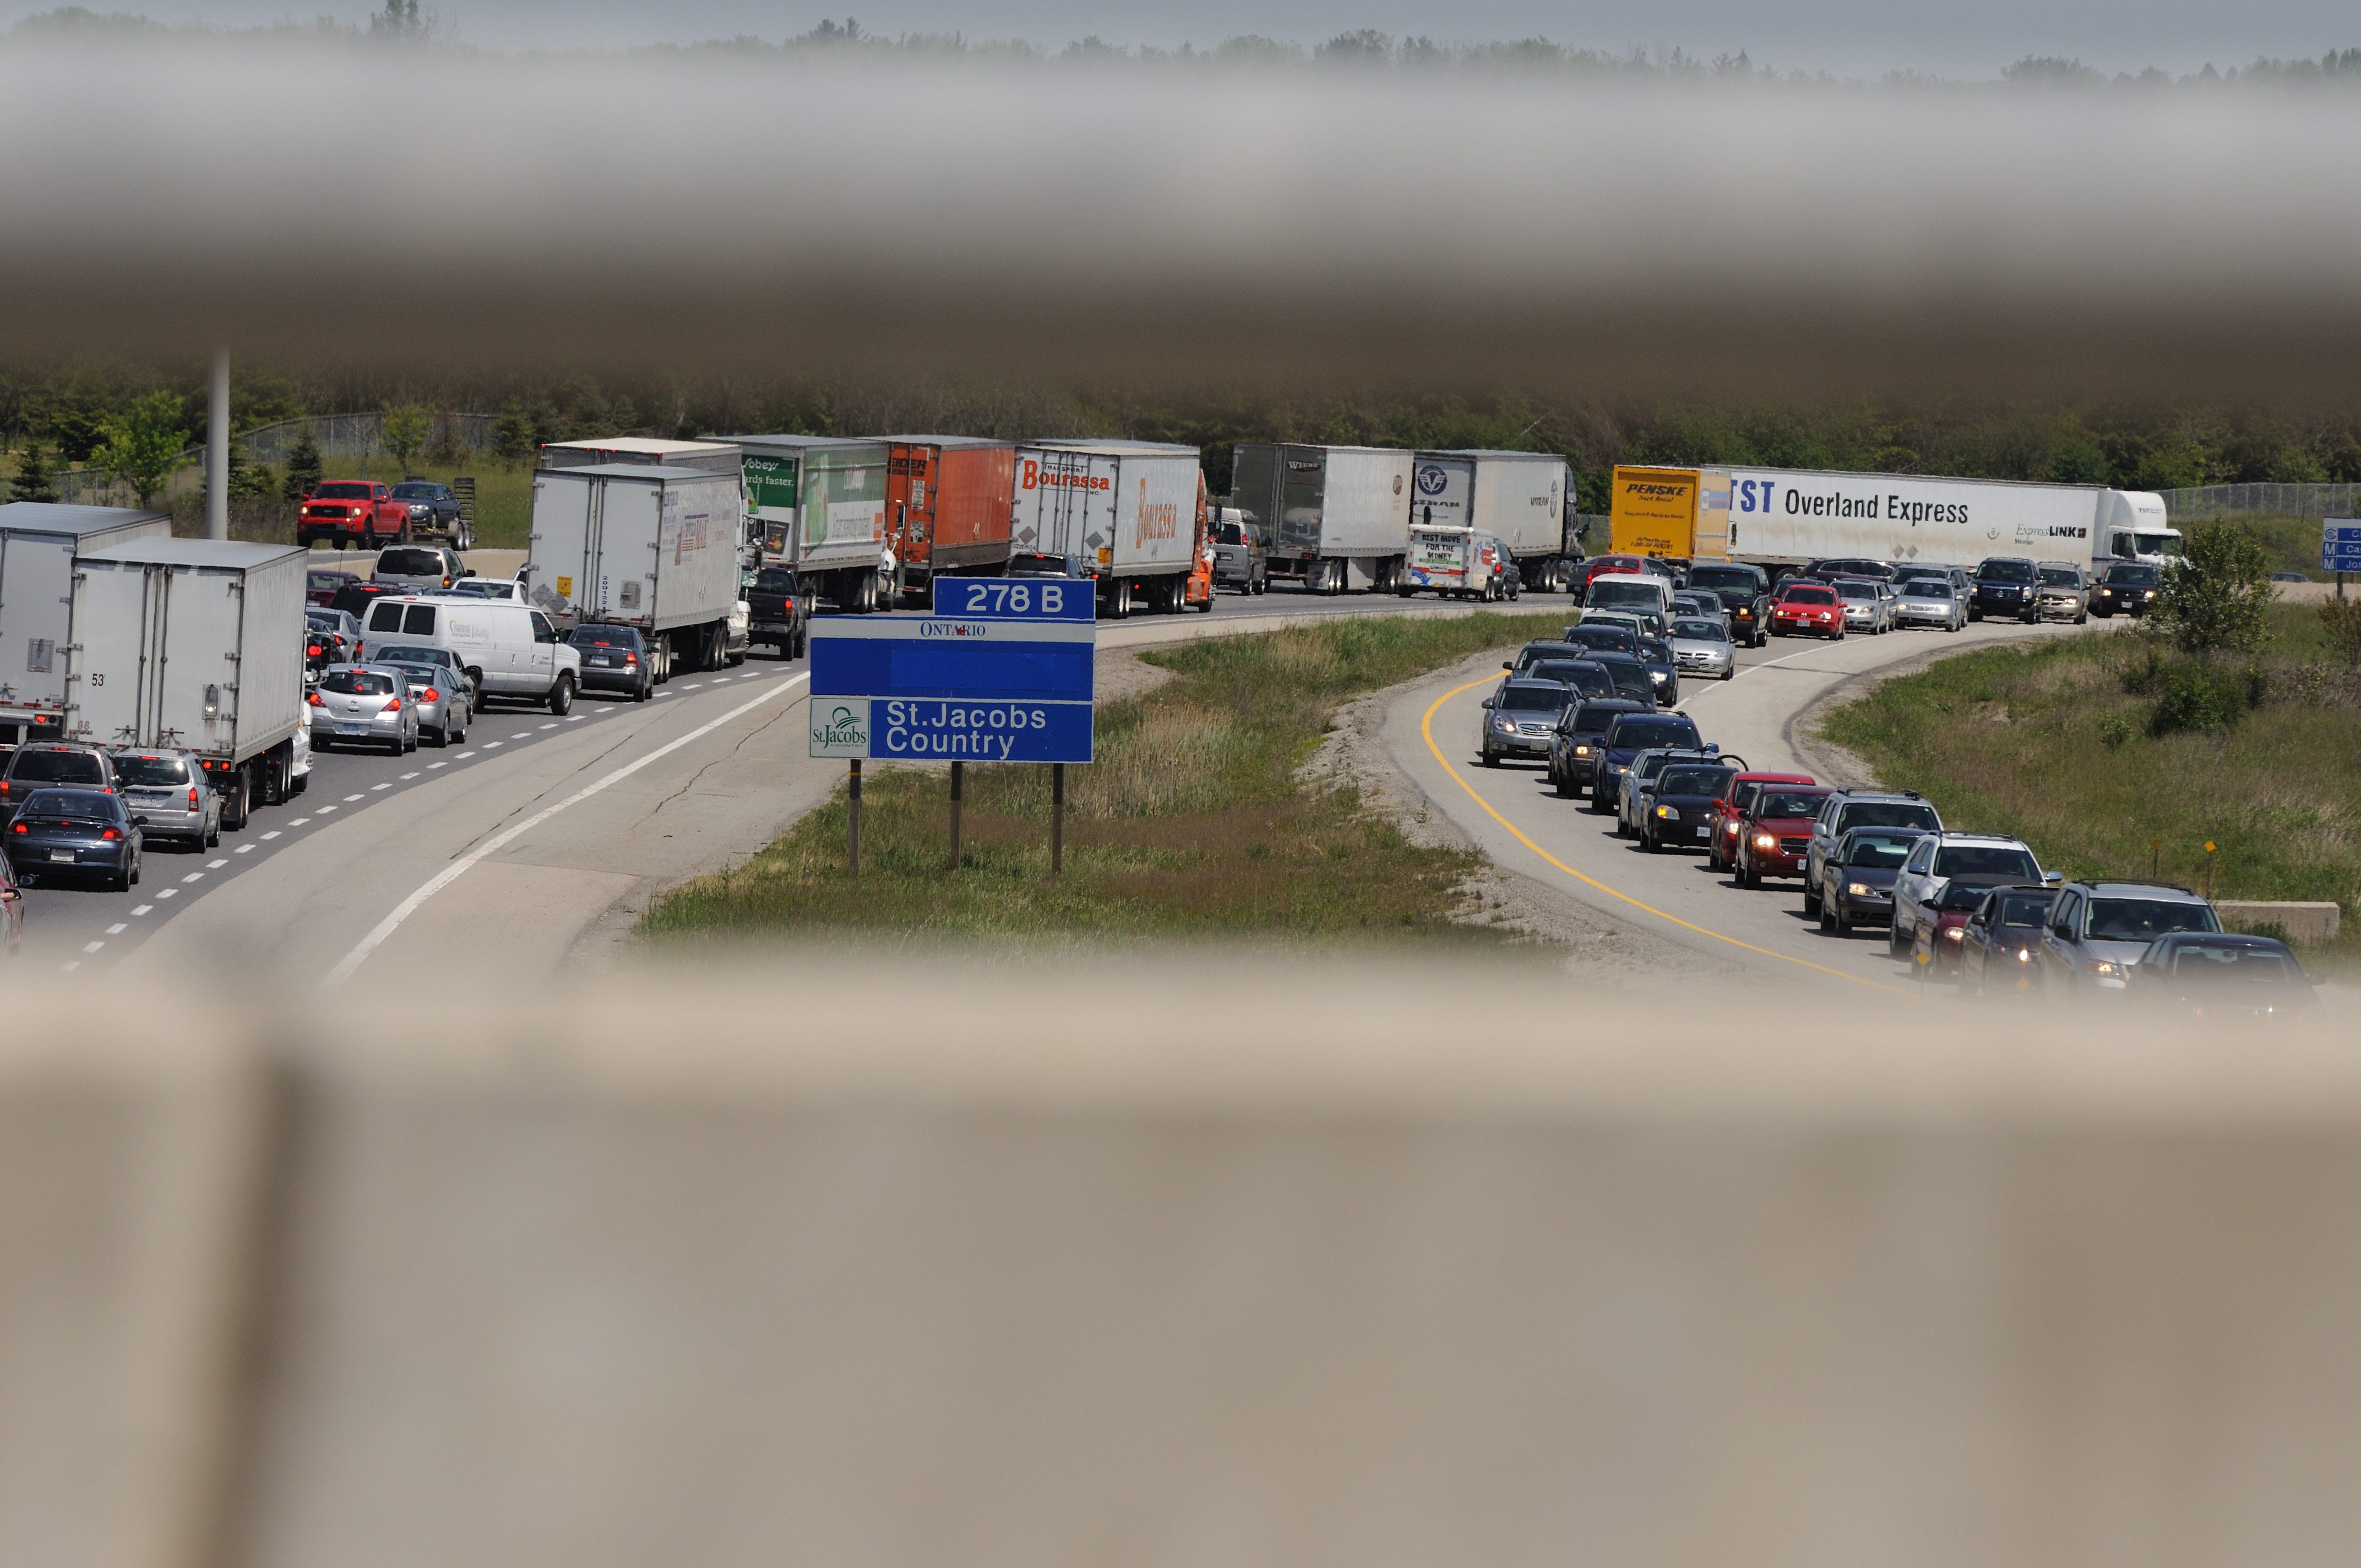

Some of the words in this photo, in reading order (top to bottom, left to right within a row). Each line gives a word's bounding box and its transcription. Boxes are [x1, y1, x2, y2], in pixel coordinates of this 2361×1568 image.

[744, 458, 779, 471] Sobeys
[765, 476, 795, 486] faster.
[1022, 460, 1109, 490] Bourassa
[1626, 484, 1688, 496] PENSKE
[1785, 489, 1878, 519] Overland
[1888, 495, 1968, 526] Express
[1427, 552, 1452, 560] MONEY
[966, 584, 1030, 612] 278
[1042, 585, 1063, 612] B
[920, 622, 986, 637] ONTARIO
[886, 727, 1014, 760] Country
